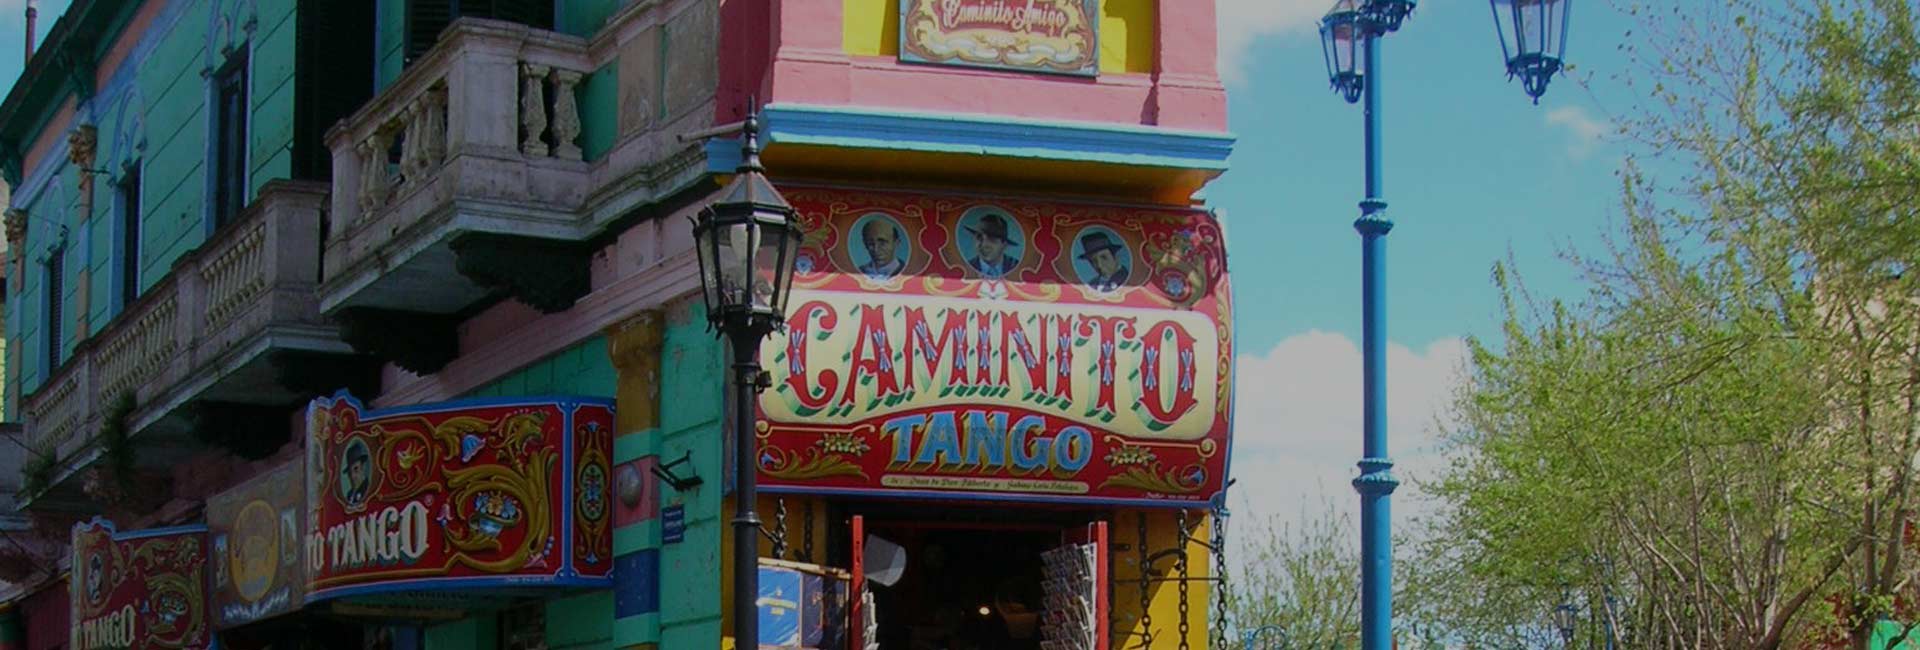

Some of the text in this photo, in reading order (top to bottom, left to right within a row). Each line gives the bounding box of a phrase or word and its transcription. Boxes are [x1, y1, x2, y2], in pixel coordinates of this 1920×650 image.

[943, 0, 1066, 36] Caminito Amigo
[784, 301, 1198, 428] CAMINITO
[881, 410, 1094, 476] TANGO
[327, 500, 430, 567] TANGO
[82, 604, 136, 650] TANGO
